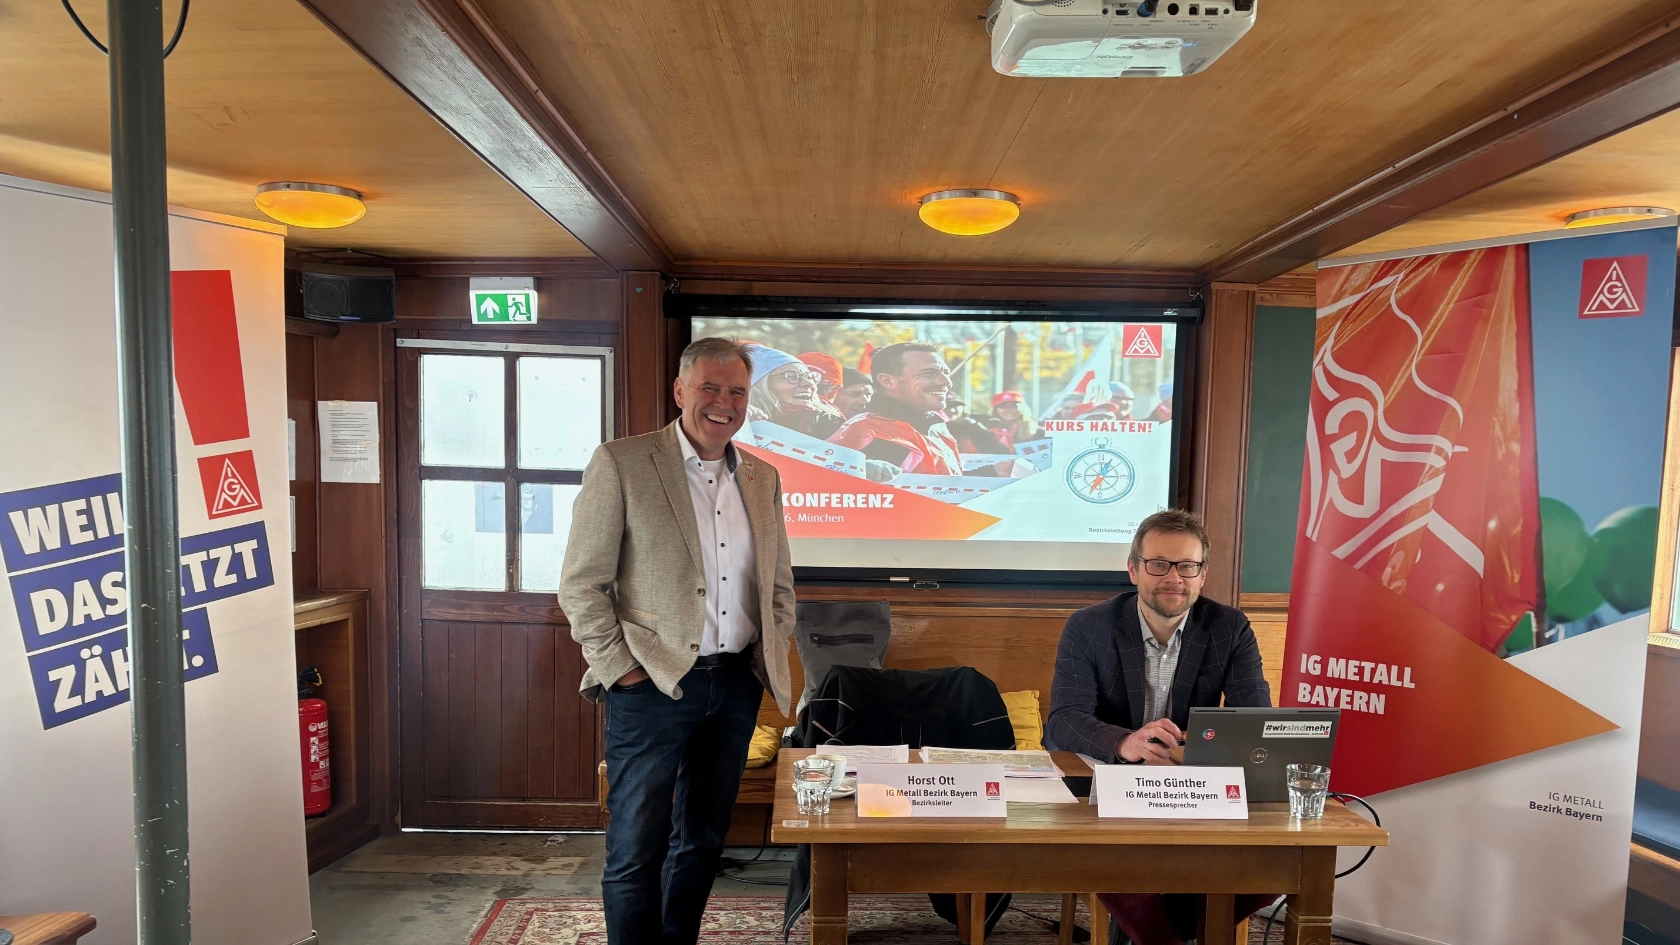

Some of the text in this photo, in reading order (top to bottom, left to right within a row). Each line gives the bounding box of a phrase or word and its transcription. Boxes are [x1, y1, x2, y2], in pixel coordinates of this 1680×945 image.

[1045, 421, 1153, 433] KURS HALTEN!
[797, 512, 844, 523] München
[29, 539, 259, 636] DAS TZT
[1300, 653, 1416, 689] IG METALL
[1297, 682, 1386, 715] BAYERN
[1265, 723, 1330, 732] #wirsindmehr
[907, 775, 956, 785] Horst Ott
[1135, 777, 1207, 788] Timo Günther
[885, 789, 895, 797] IG
[896, 789, 922, 797] Metall
[923, 789, 949, 797] Bezirk
[950, 789, 978, 799] Bayern
[1136, 791, 1162, 799] Metall
[1163, 791, 1189, 799] Bezirk
[1190, 791, 1219, 801] Bayern
[1148, 801, 1198, 809] Pressesprecher
[1548, 791, 1605, 810] IG METALL
[1529, 800, 1603, 822] Bezirk Bayern
